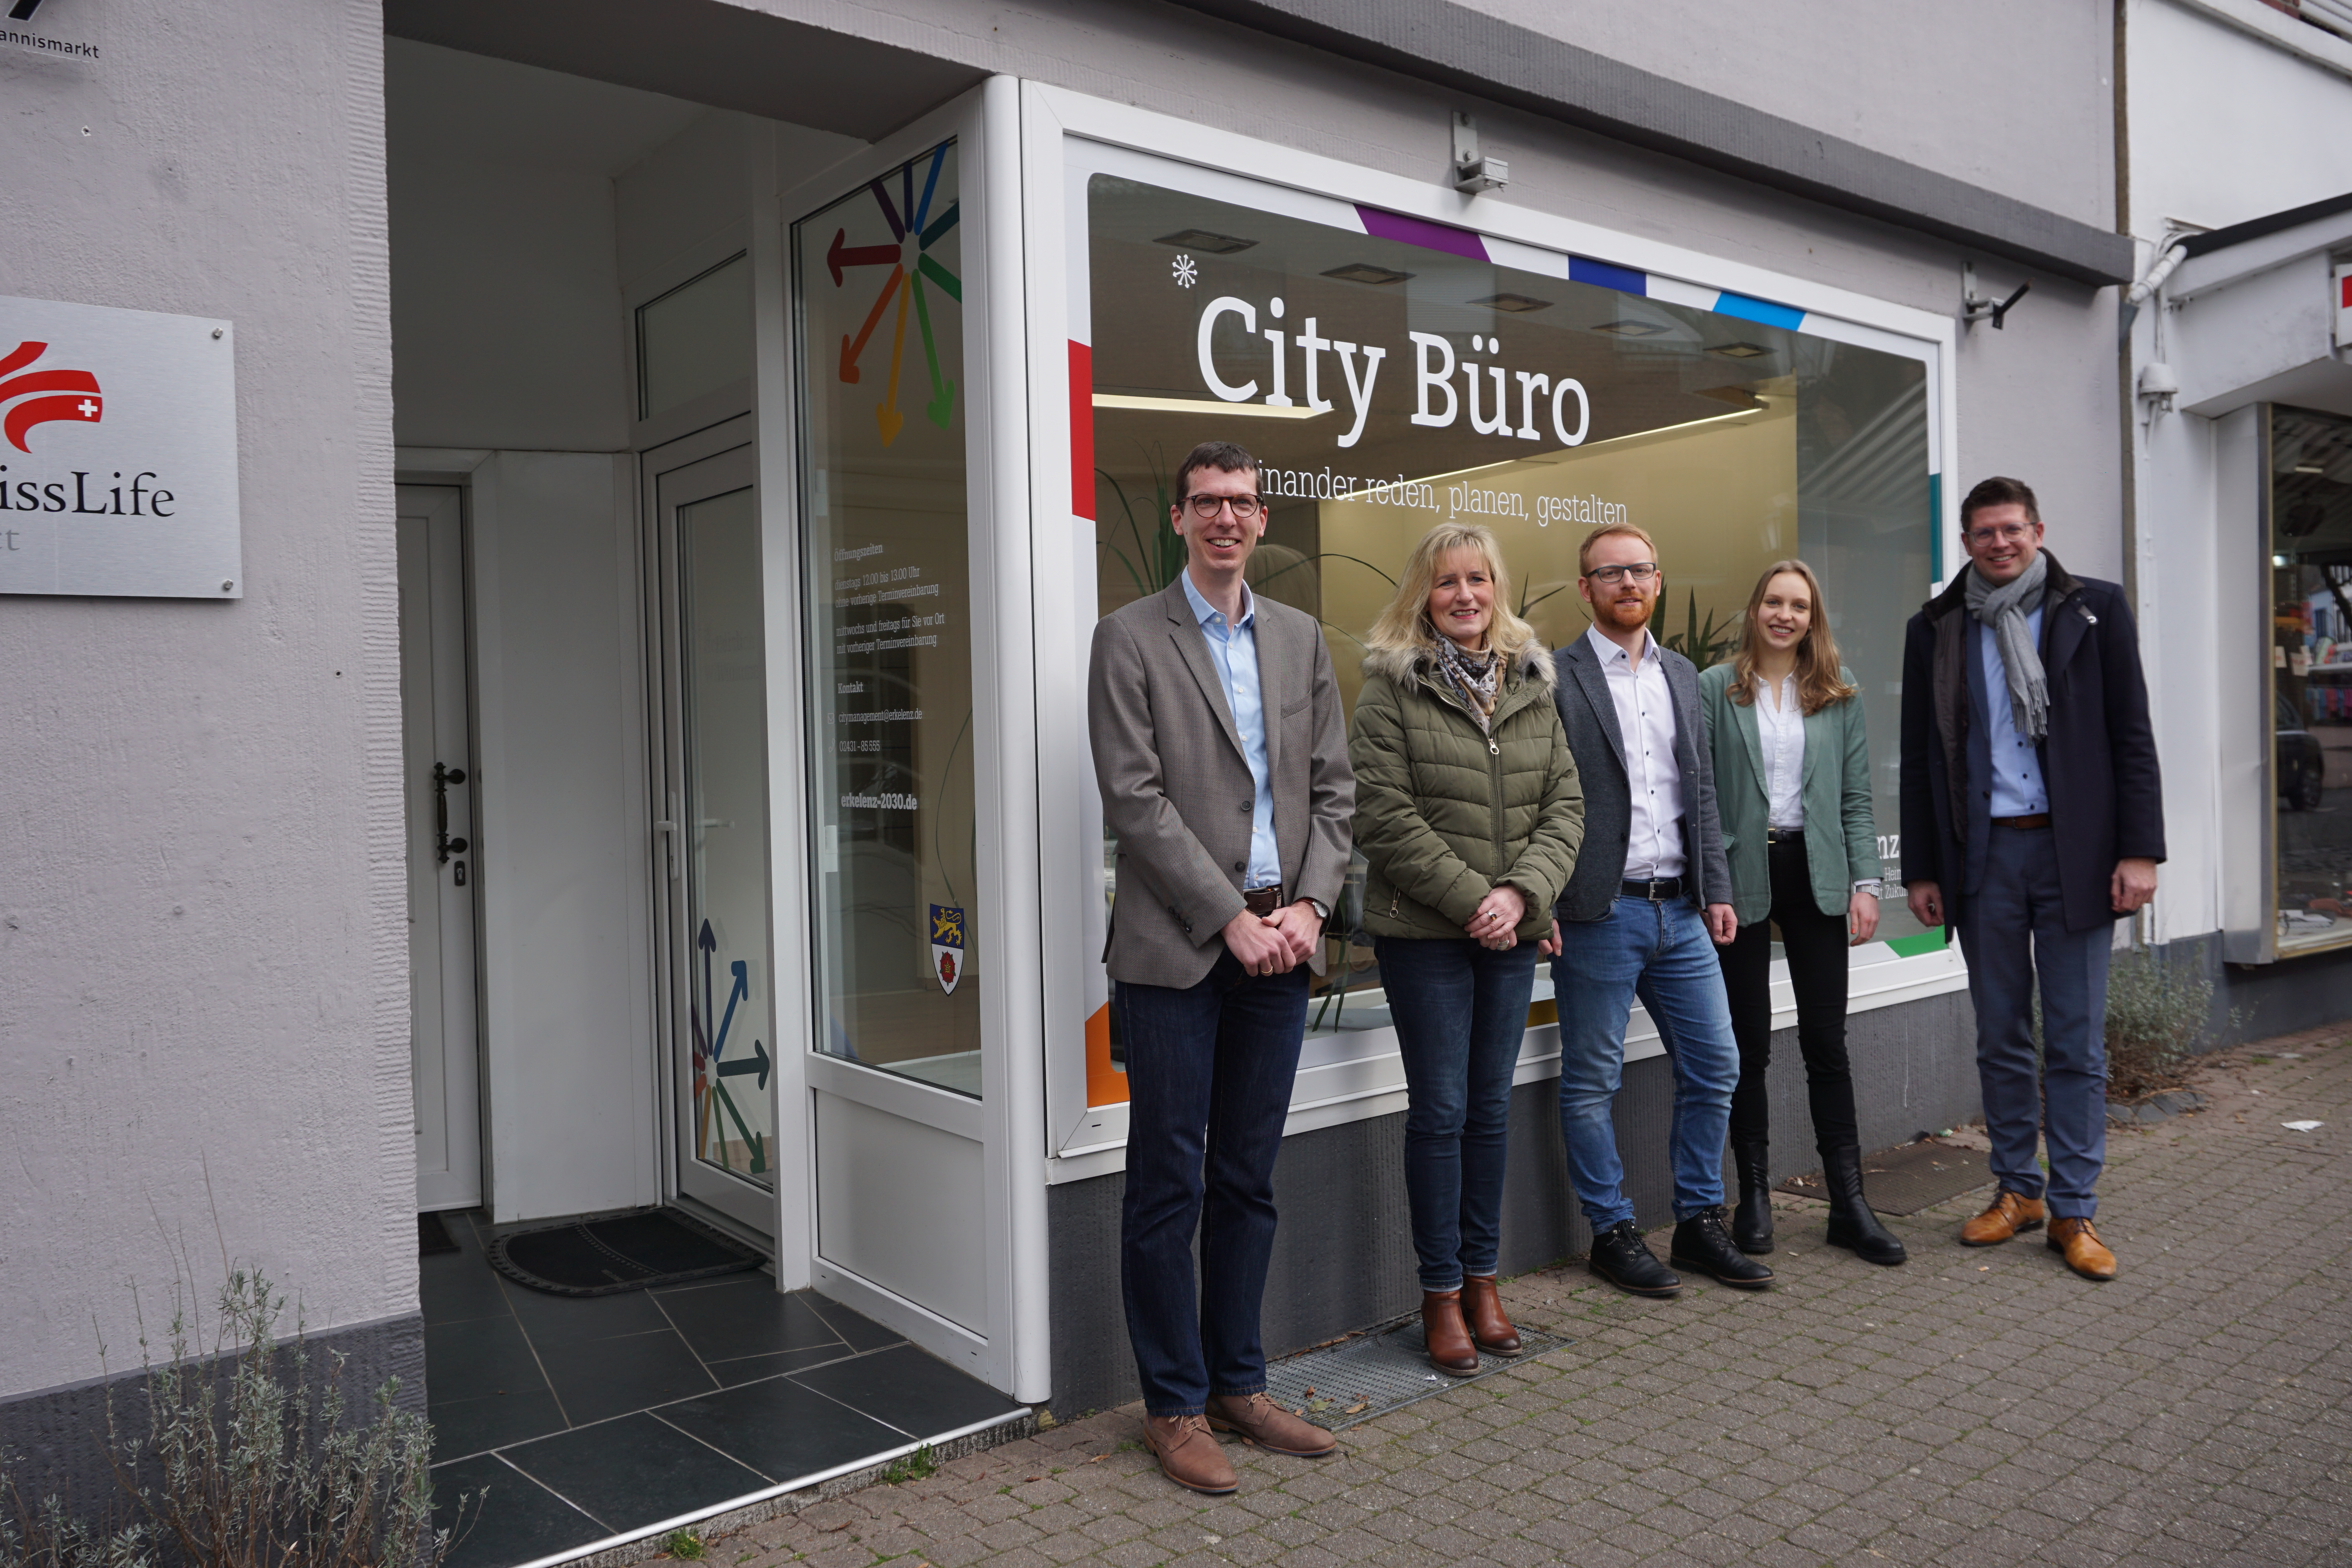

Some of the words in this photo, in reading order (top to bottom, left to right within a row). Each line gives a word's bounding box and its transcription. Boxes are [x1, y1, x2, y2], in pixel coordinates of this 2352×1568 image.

[1198, 296, 1386, 448] City
[1410, 331, 1590, 446] Büro
[1366, 474, 1440, 513] reden,
[1449, 481, 1529, 521] planen,
[1537, 494, 1627, 527] gestalten
[834, 543, 883, 561] Öffnungszeiten
[835, 577, 860, 590] dienstags
[863, 573, 878, 586] 12.00
[880, 571, 888, 583] bis
[891, 568, 907, 581] 13.00
[909, 566, 920, 578] Uhr
[835, 597, 849, 608] ohne
[850, 592, 877, 606] vorherige
[878, 584, 939, 602] Terminvereinbarung
[836, 623, 864, 636] mittwochs
[866, 621, 877, 633] und
[878, 619, 900, 633] freitags
[902, 617, 911, 628] für
[912, 615, 921, 628] Sie
[923, 616, 933, 626] vor
[935, 612, 945, 624] Ort
[837, 643, 846, 654] mit
[847, 641, 875, 654] vorheriger
[876, 634, 937, 650] Terminvereinbarung
[838, 681, 863, 694] Kontakt
[838, 708, 922, 725] citymanagement@erkelenz.de
[841, 792, 917, 810] erkelenz-2030.de
